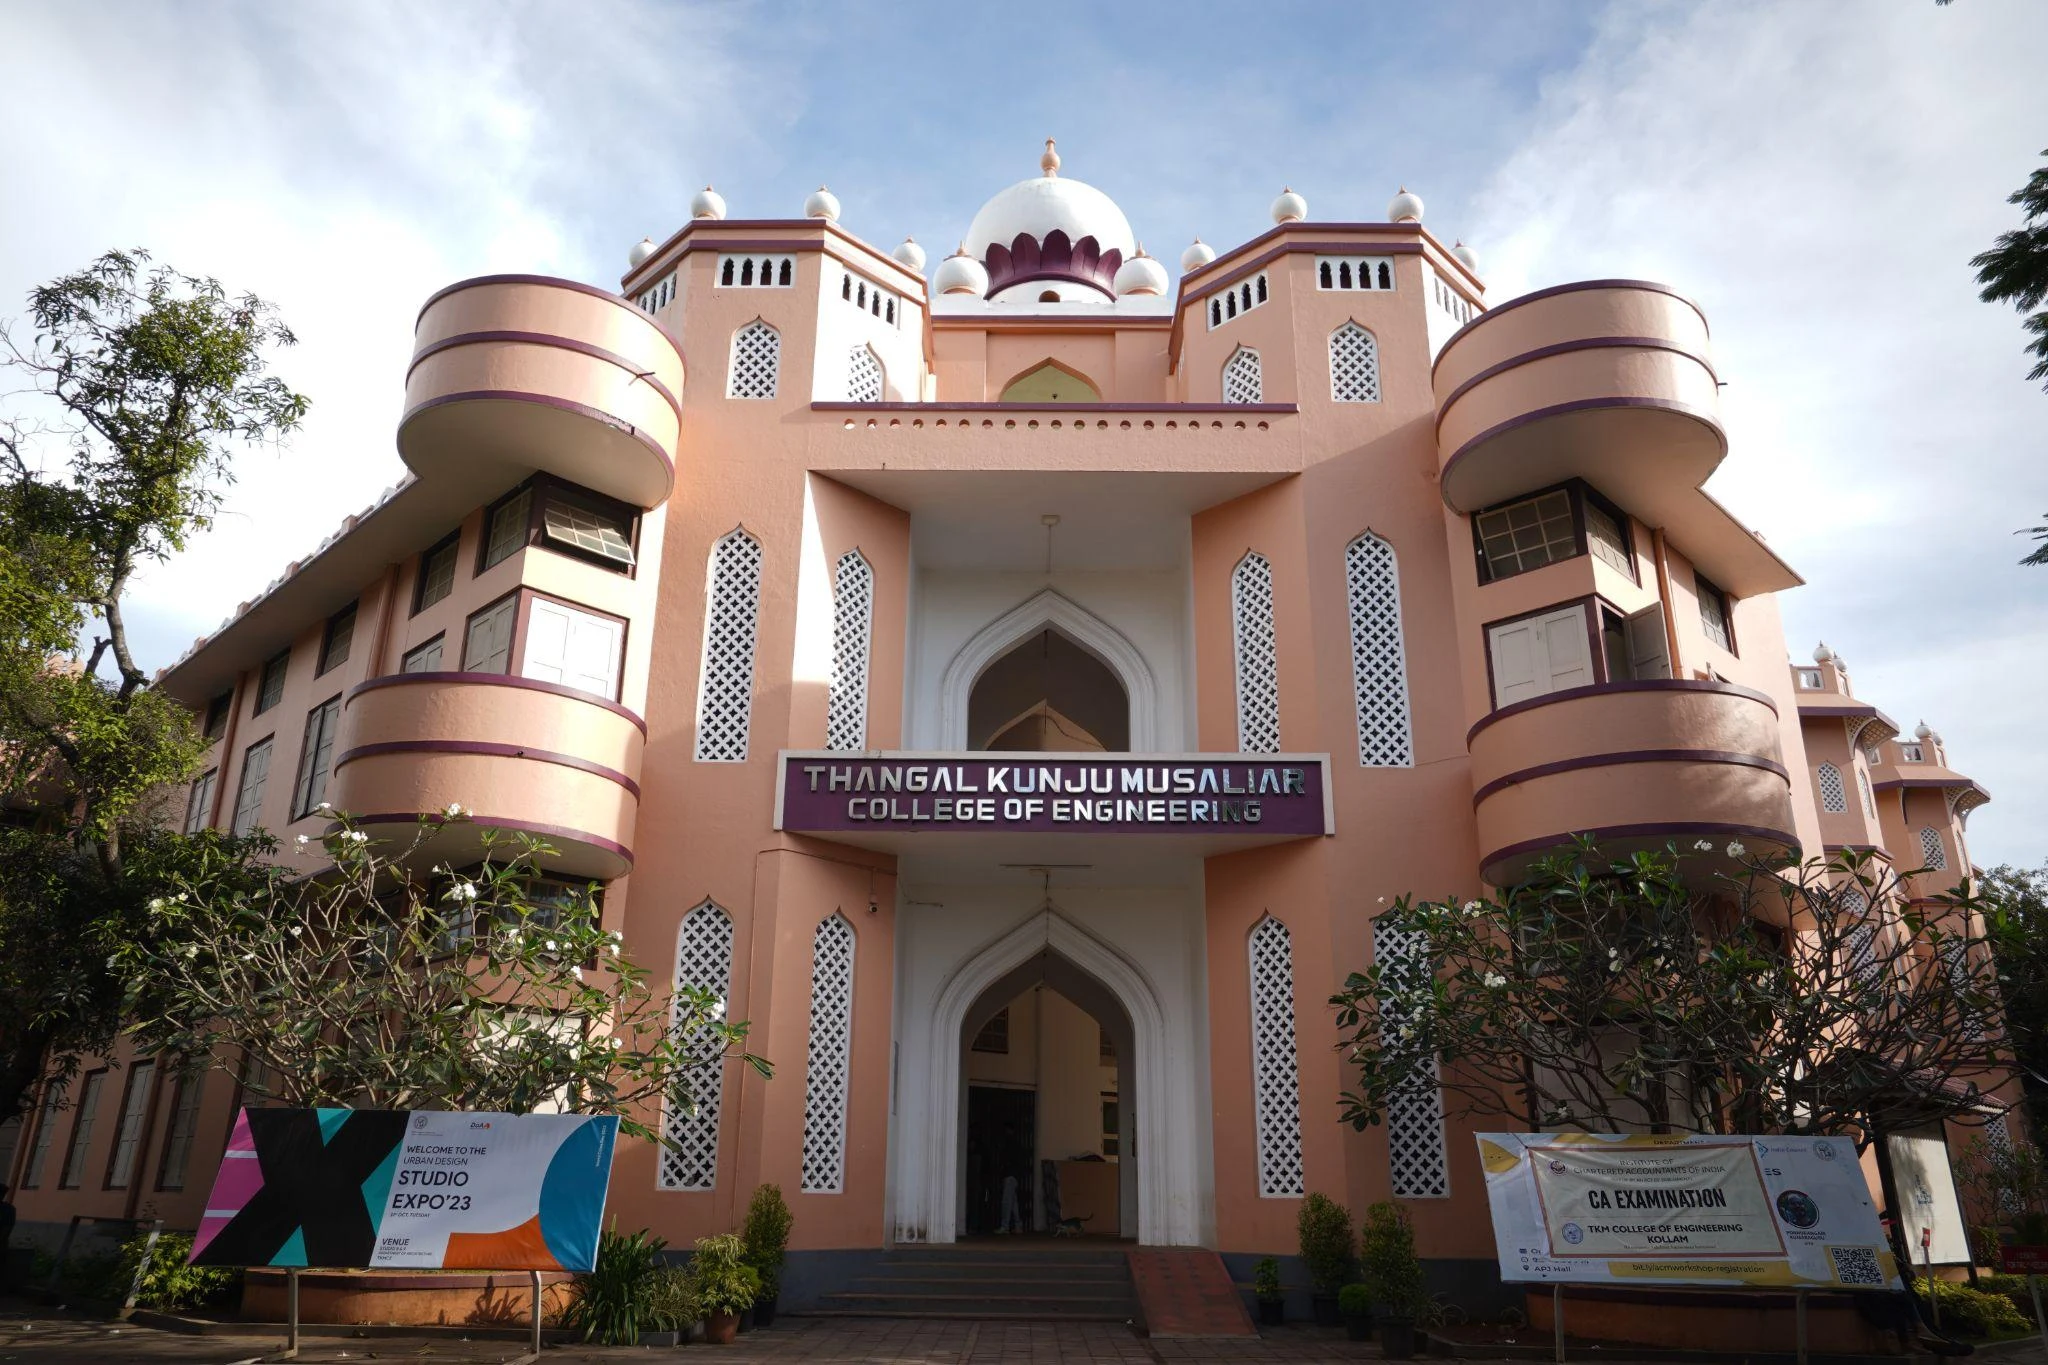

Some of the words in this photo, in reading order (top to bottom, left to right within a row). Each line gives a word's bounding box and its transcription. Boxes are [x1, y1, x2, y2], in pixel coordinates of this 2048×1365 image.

[803, 765, 979, 793] THANGAL
[987, 766, 1113, 794] KUNJU
[1120, 767, 1306, 795] MUSALIAR
[848, 798, 996, 821] COLLEGE
[1003, 798, 1044, 821] OF
[1052, 799, 1262, 823] ENGINEERING
[407, 1145, 453, 1154] WELCOME
[455, 1146, 467, 1155] TO
[469, 1147, 487, 1155] THE
[403, 1156, 434, 1165] URBAN
[435, 1157, 469, 1166] DESIGN
[1619, 1159, 1660, 1167] INSTITUTE
[1574, 1167, 1624, 1175] CHARTERED
[1625, 1166, 1687, 1175] ACCOUNTANTS
[1688, 1166, 1699, 1174] OF
[398, 1169, 469, 1187] STUDIO
[391, 1193, 472, 1211] EXPO'23
[1588, 1189, 1612, 1209] CA
[1614, 1188, 1727, 1209] EXAMINATION
[1588, 1225, 1610, 1233] TKM
[1612, 1225, 1657, 1234] COLLEGE
[1658, 1224, 1672, 1233] OF
[1674, 1224, 1744, 1233] ENGINEERING
[382, 1238, 410, 1246] VENUE
[1647, 1235, 1689, 1244] KOLLAM
